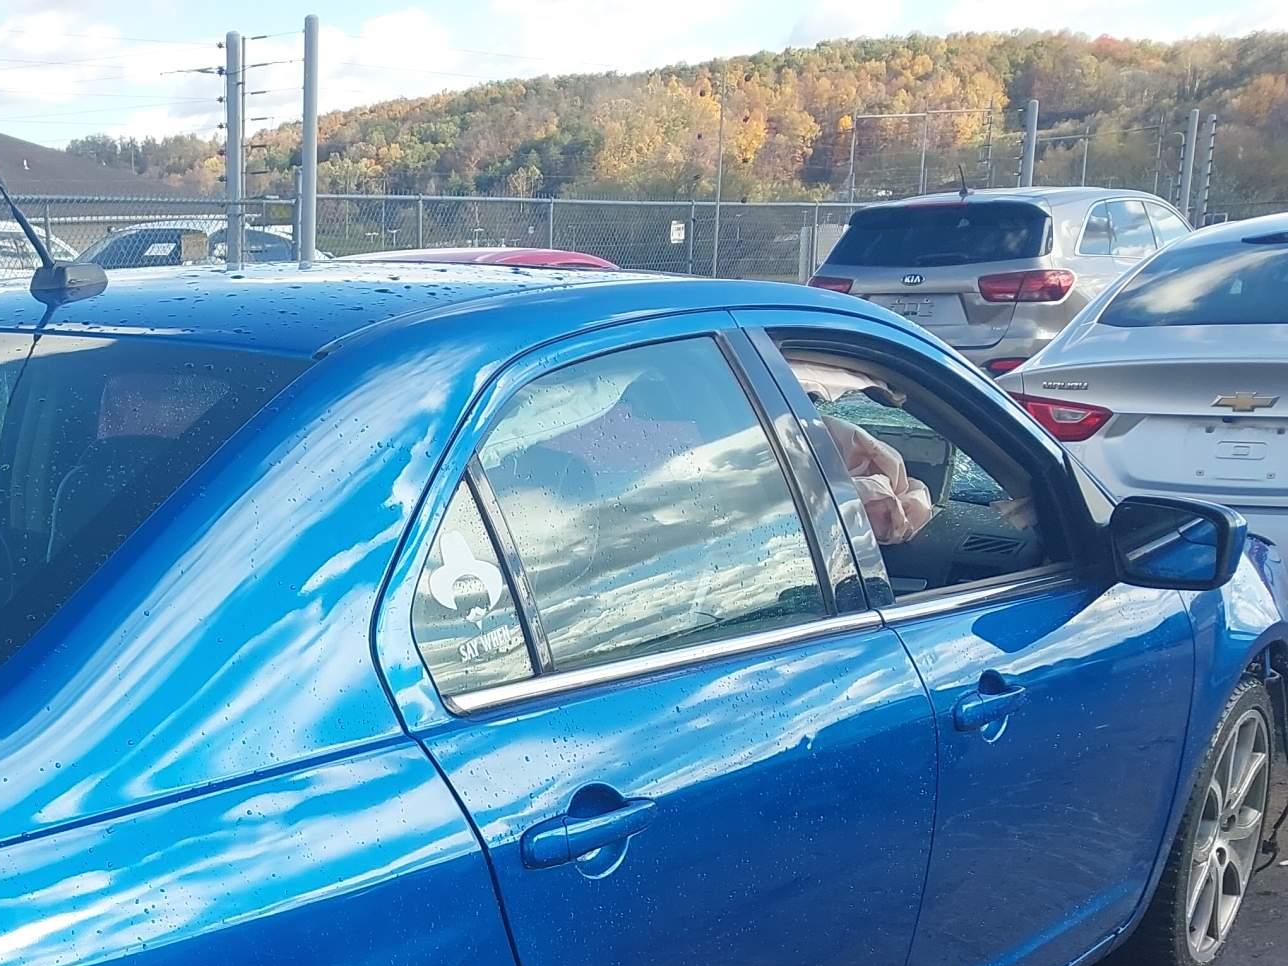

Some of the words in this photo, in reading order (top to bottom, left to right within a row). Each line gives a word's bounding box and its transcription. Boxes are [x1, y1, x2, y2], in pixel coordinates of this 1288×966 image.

[904, 275, 921, 283] KIA
[458, 643, 479, 662] SAY
[479, 625, 512, 652] WHEN
